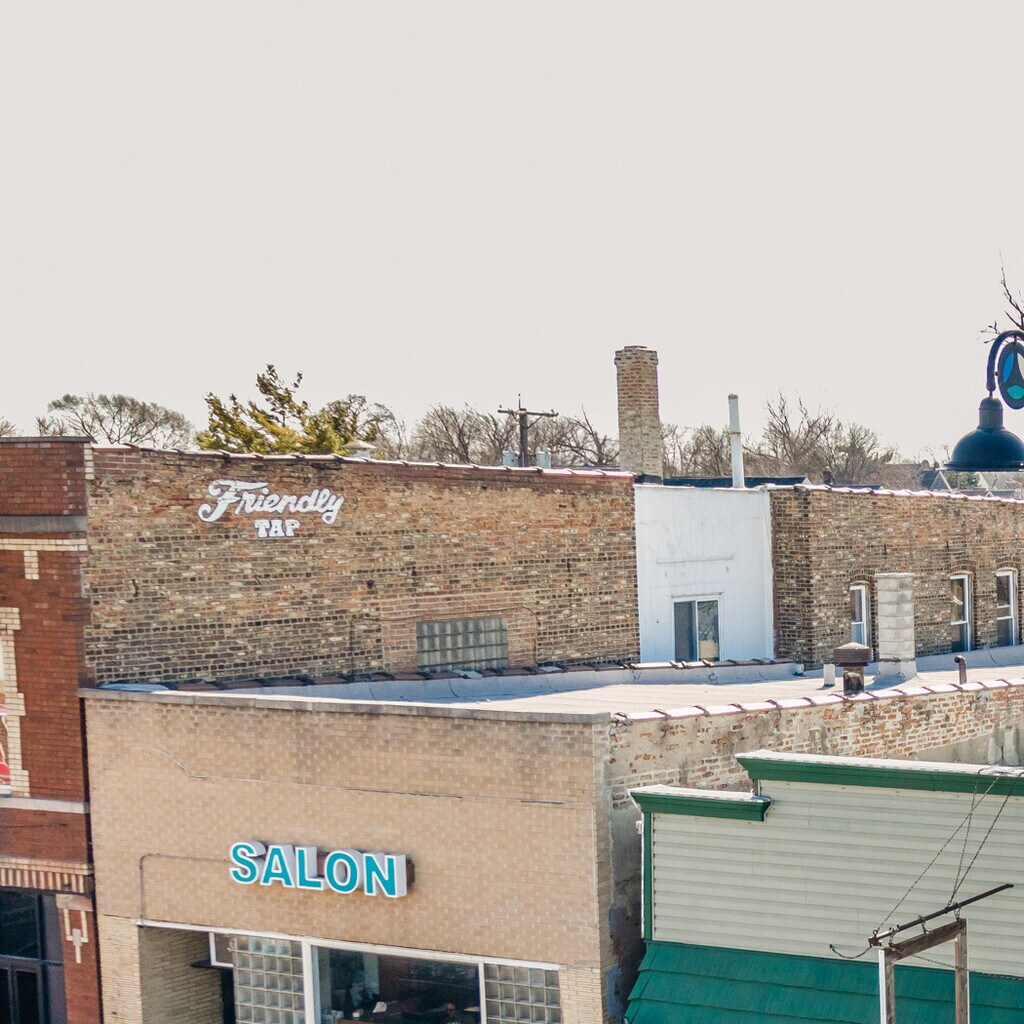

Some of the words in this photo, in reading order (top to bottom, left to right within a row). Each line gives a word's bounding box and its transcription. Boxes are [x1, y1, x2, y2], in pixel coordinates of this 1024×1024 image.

[198, 479, 345, 525] Friendly
[254, 519, 300, 538] TAP
[229, 841, 405, 898] SALON
